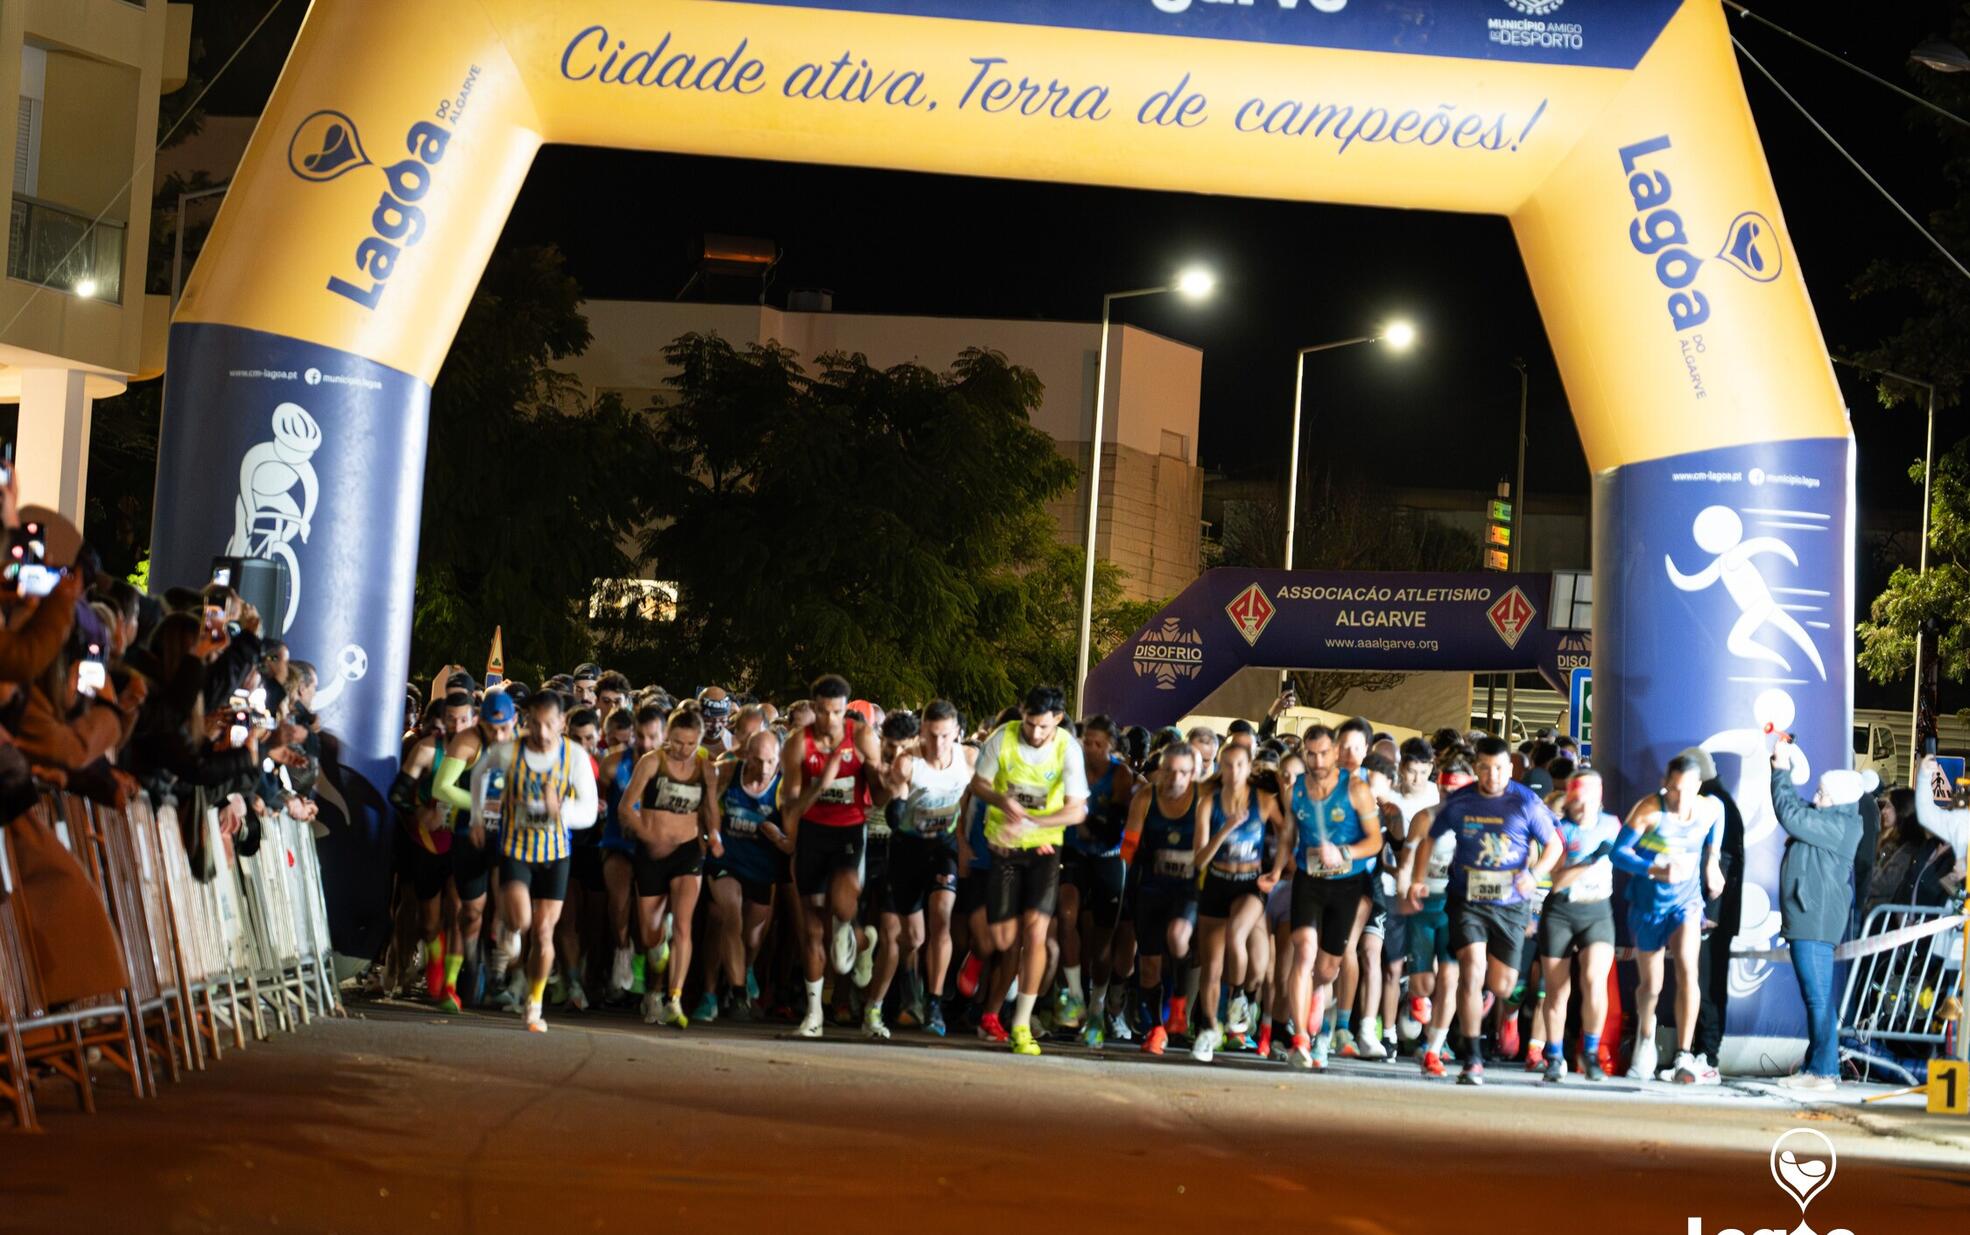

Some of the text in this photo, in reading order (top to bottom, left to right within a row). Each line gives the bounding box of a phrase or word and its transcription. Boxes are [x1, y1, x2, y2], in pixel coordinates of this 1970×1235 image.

[1487, 18, 1583, 34] MUNICÍPIO AMIGO
[1500, 30, 1583, 50] DESPORTO
[449, 64, 481, 125] ALGARVE
[560, 25, 1548, 155] Cidade ativa, Terra de campeões!
[435, 99, 451, 119] DO
[326, 121, 451, 310] Lagoa
[1618, 134, 1710, 331] Lagoa
[1692, 334, 1706, 353] DO
[229, 368, 298, 380] www.cm-lagoa.pt
[1680, 339, 1707, 400] ALGARVE
[1672, 471, 1742, 483] www.cm-lagoa.pt
[1395, 588, 1491, 601] ATLETISMO
[1335, 610, 1427, 627] ALGARVE
[1135, 645, 1202, 660] DISOFRIO
[1325, 637, 1439, 651] www.aaalgarve.org
[1557, 655, 1592, 668] DISO
[1936, 1067, 1957, 1108] 1
